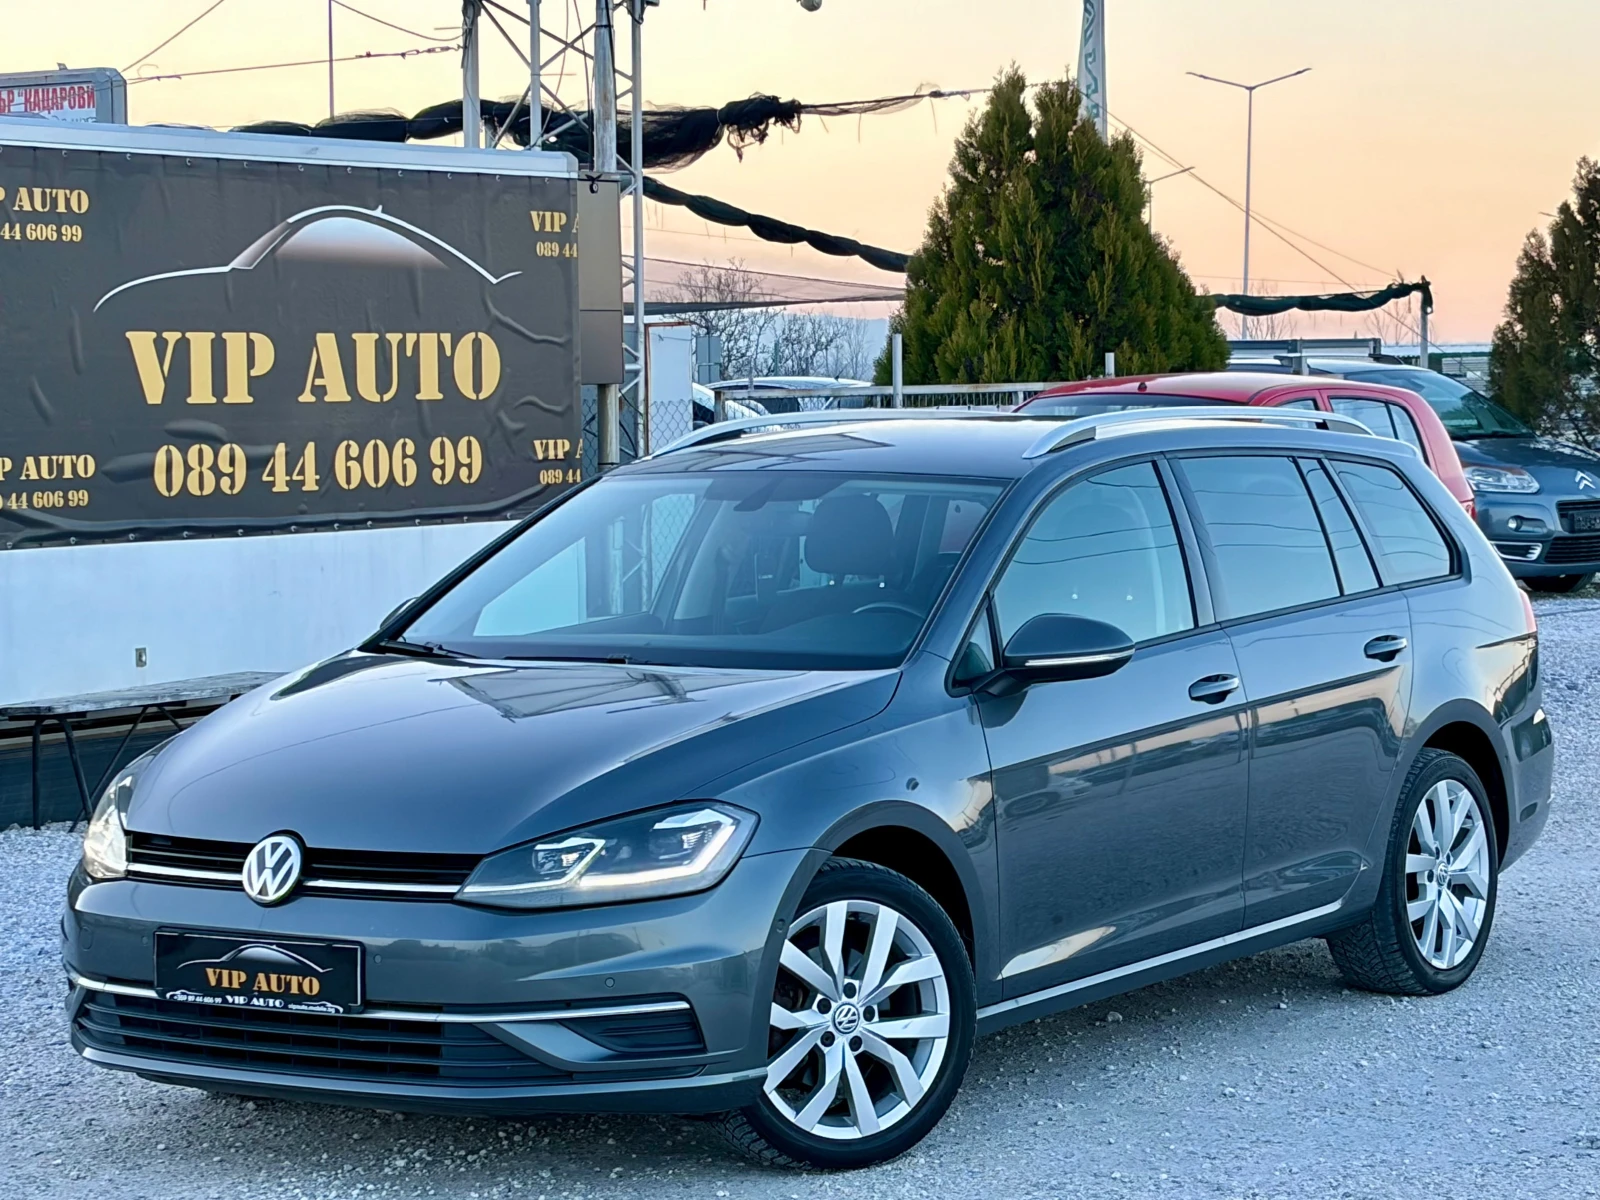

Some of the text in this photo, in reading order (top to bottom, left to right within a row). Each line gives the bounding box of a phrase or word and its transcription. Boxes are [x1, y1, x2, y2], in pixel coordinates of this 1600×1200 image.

[13, 187, 90, 214] AUTO
[530, 211, 567, 232] VIP
[0, 223, 82, 242] 44 606 99
[536, 242, 578, 257] 089 44
[124, 331, 501, 404] VIP AUTO
[533, 439, 570, 460] VIP
[19, 454, 95, 479] AUTO
[153, 436, 483, 497] 089 44 606 99
[540, 469, 581, 484] 089 44
[7, 492, 28, 509] 44
[33, 491, 64, 508] 606
[68, 489, 89, 507] 99
[243, 836, 300, 900] VW
[205, 967, 320, 996] VIP AUTO
[225, 995, 248, 1004] VIP
[250, 997, 285, 1008] AUTO
